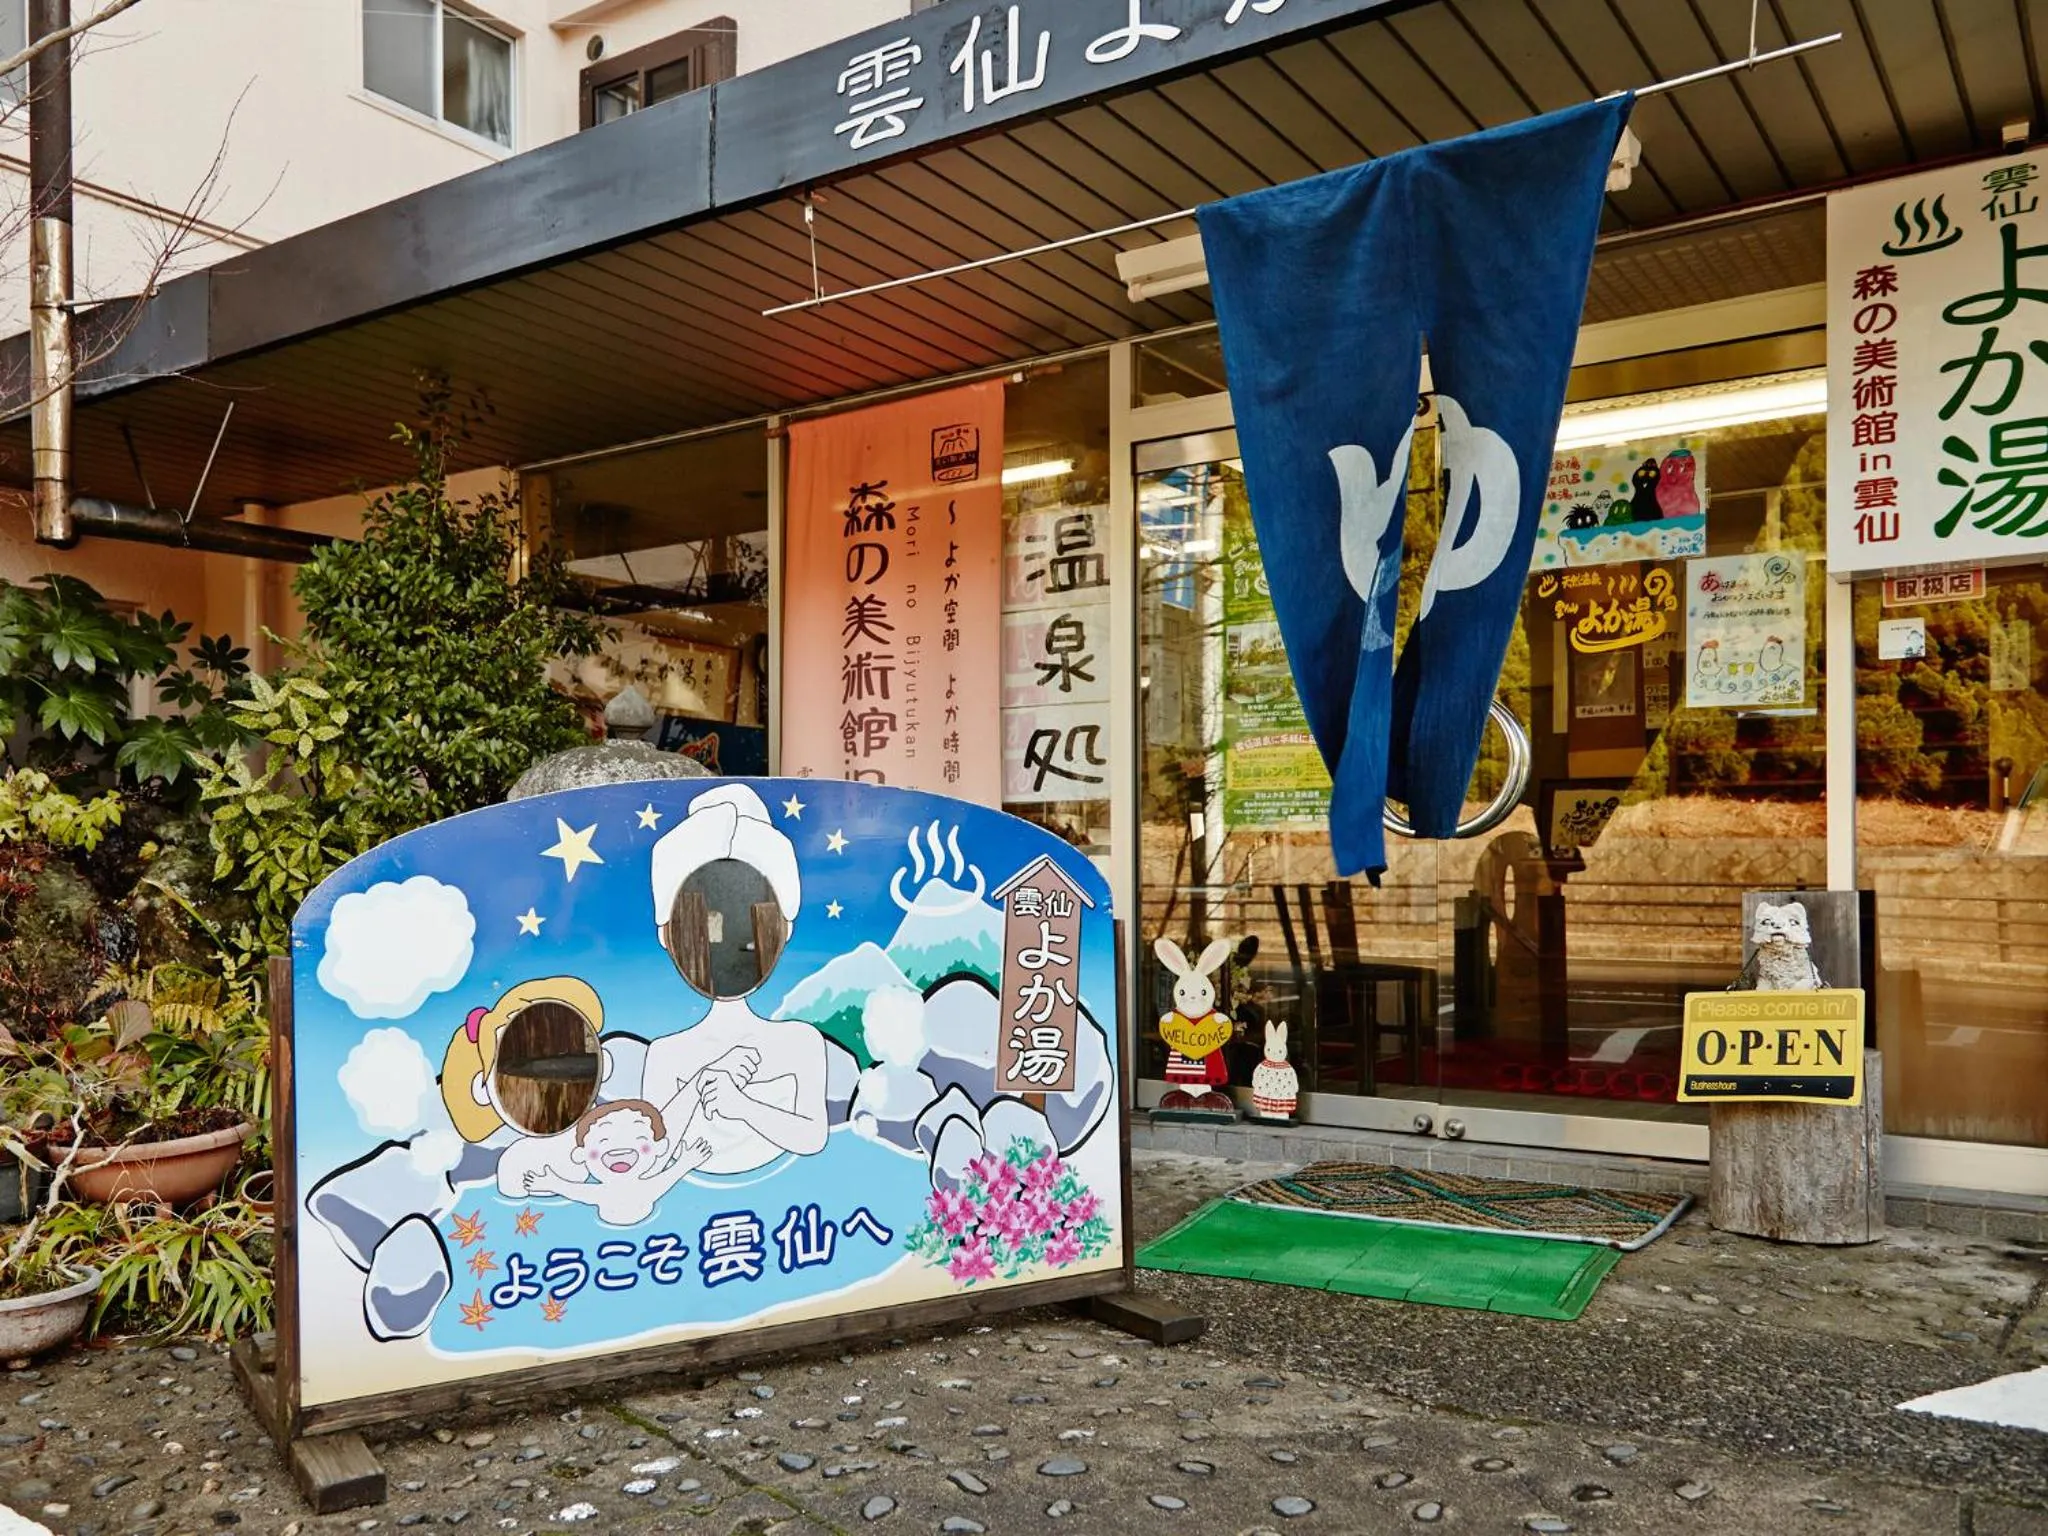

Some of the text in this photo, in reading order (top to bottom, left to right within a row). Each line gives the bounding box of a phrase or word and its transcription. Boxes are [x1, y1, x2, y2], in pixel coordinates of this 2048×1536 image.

[1980, 162, 2041, 221] 雲仙
[1851, 263, 1900, 546] 森の美術館in雲仙
[904, 506, 921, 557] Mori
[1327, 393, 1521, 622] ゆ
[905, 584, 917, 609] no
[1896, 573, 1972, 599] 取扱店
[1578, 597, 1655, 634] よか湯
[1023, 512, 1111, 793] 温泉処
[1013, 887, 1073, 918] 雲仙
[1006, 920, 1076, 1086] よか湯
[1697, 1001, 1760, 1018] Please
[1764, 1001, 1819, 1017] come
[1163, 1025, 1227, 1047] WELCOME
[490, 1203, 894, 1309] ようこそ雲仙へ
